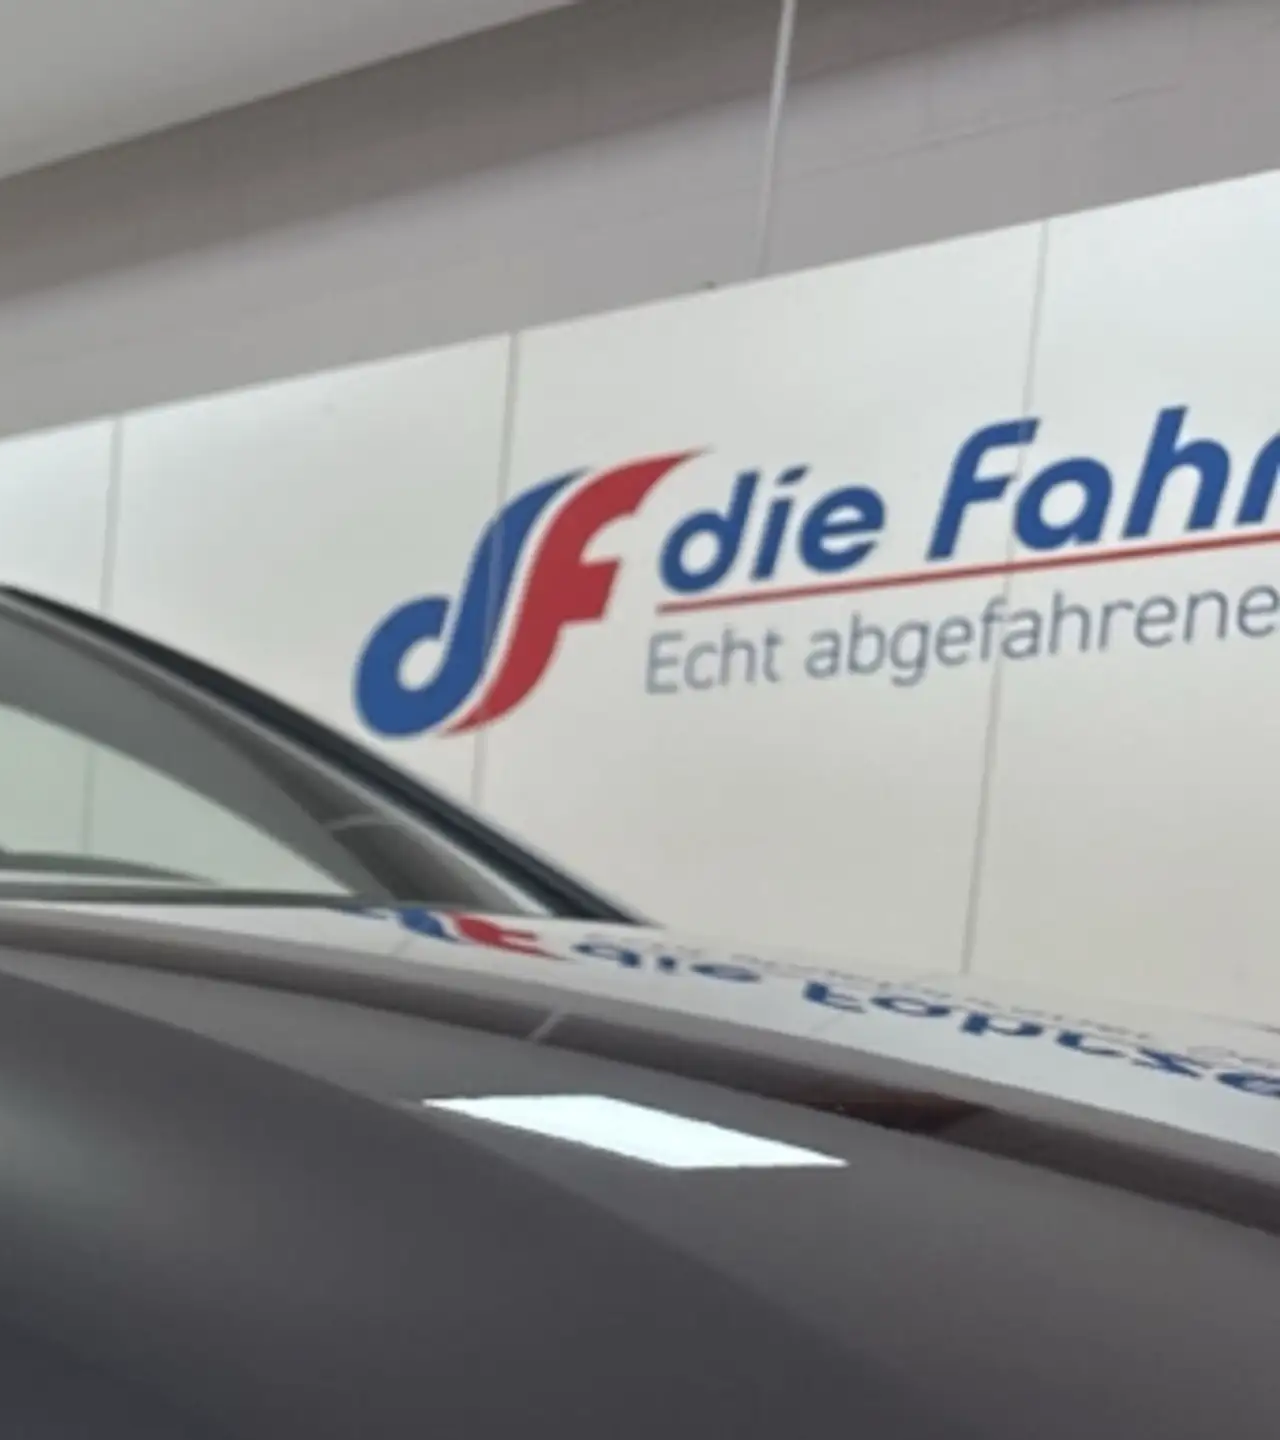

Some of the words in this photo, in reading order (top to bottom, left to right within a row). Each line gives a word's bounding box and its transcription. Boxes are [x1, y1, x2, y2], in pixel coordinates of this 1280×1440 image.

[658, 465, 886, 596] die
[645, 629, 782, 694] Echt
[794, 584, 1280, 688] abgefahrene
